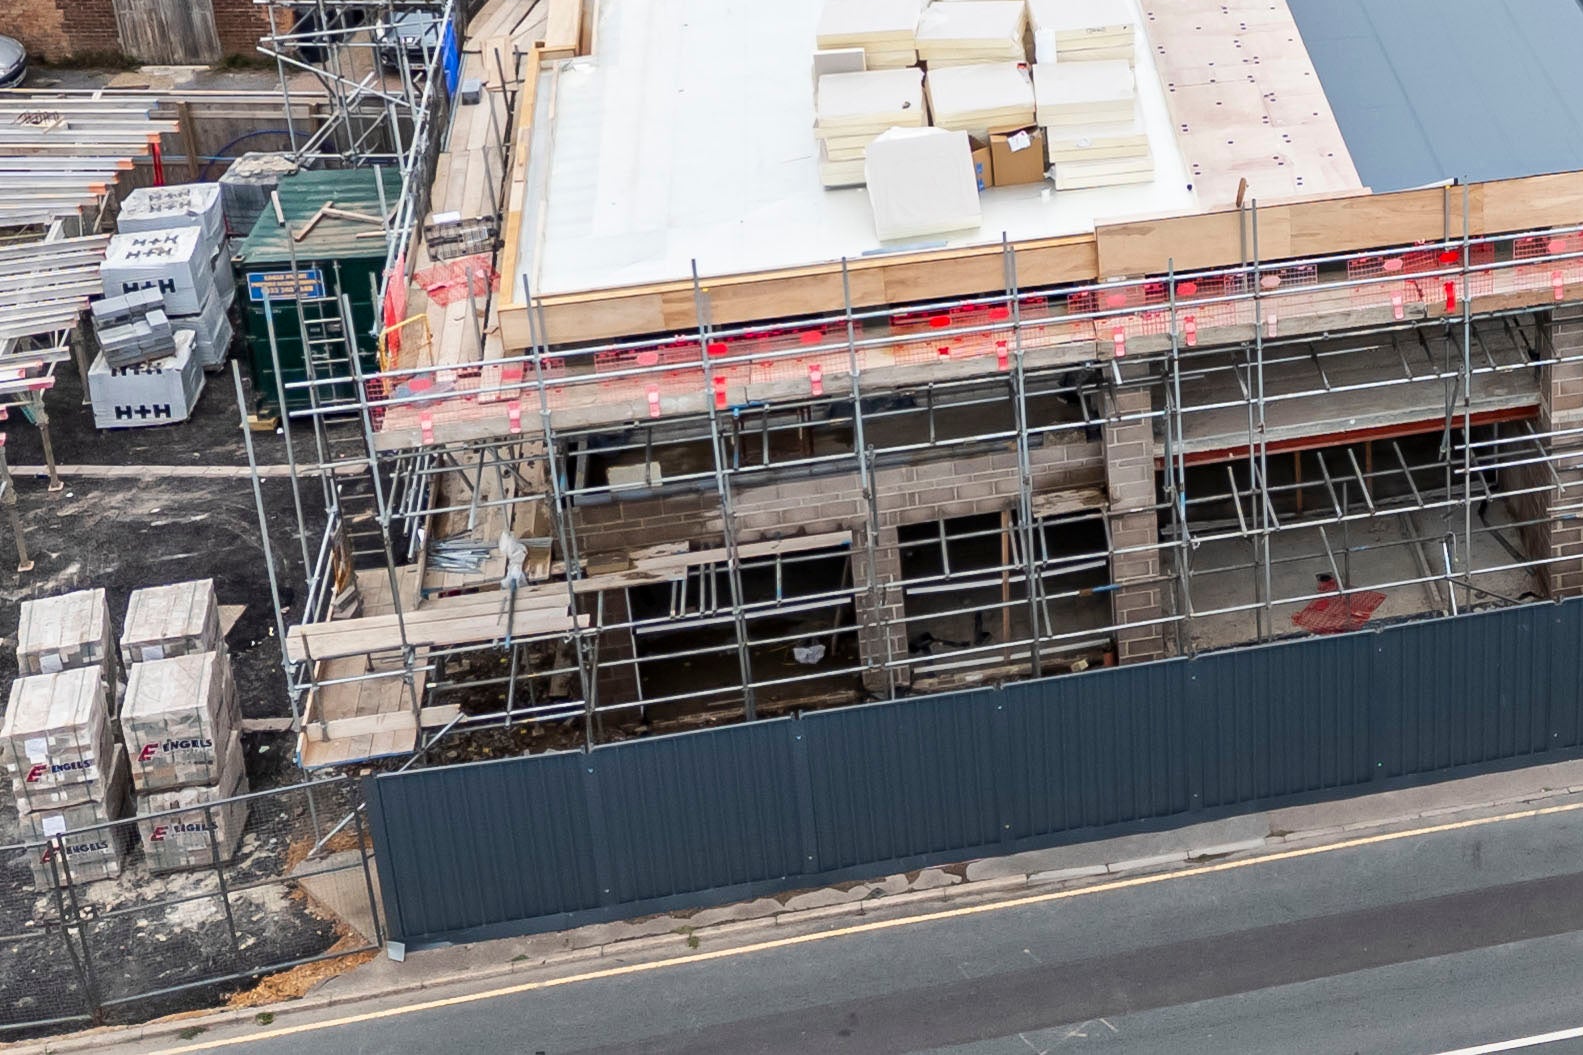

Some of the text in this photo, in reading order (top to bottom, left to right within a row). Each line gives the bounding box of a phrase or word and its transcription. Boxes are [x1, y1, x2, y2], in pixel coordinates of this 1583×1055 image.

[132, 234, 179, 246] H+H
[114, 403, 172, 420] H+H
[162, 739, 213, 752] ENGELS
[51, 759, 94, 773] ENGELS
[66, 840, 109, 854] ENGELS
